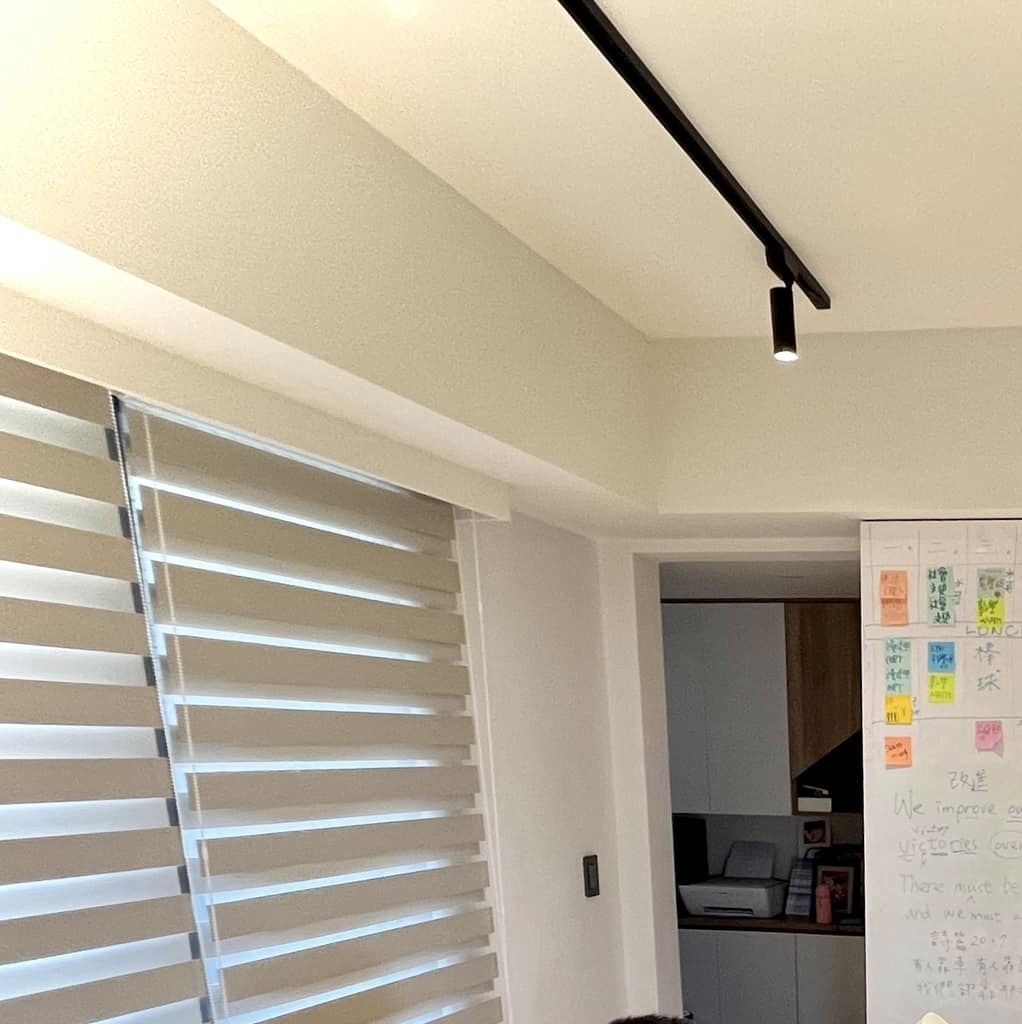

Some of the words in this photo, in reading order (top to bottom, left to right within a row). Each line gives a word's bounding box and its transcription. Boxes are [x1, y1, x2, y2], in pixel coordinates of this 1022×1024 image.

[895, 790, 925, 819] We
[936, 800, 998, 823] improve
[898, 838, 977, 852] victories
[899, 873, 944, 895] There
[953, 879, 992, 895] must
[1003, 875, 1020, 895] be
